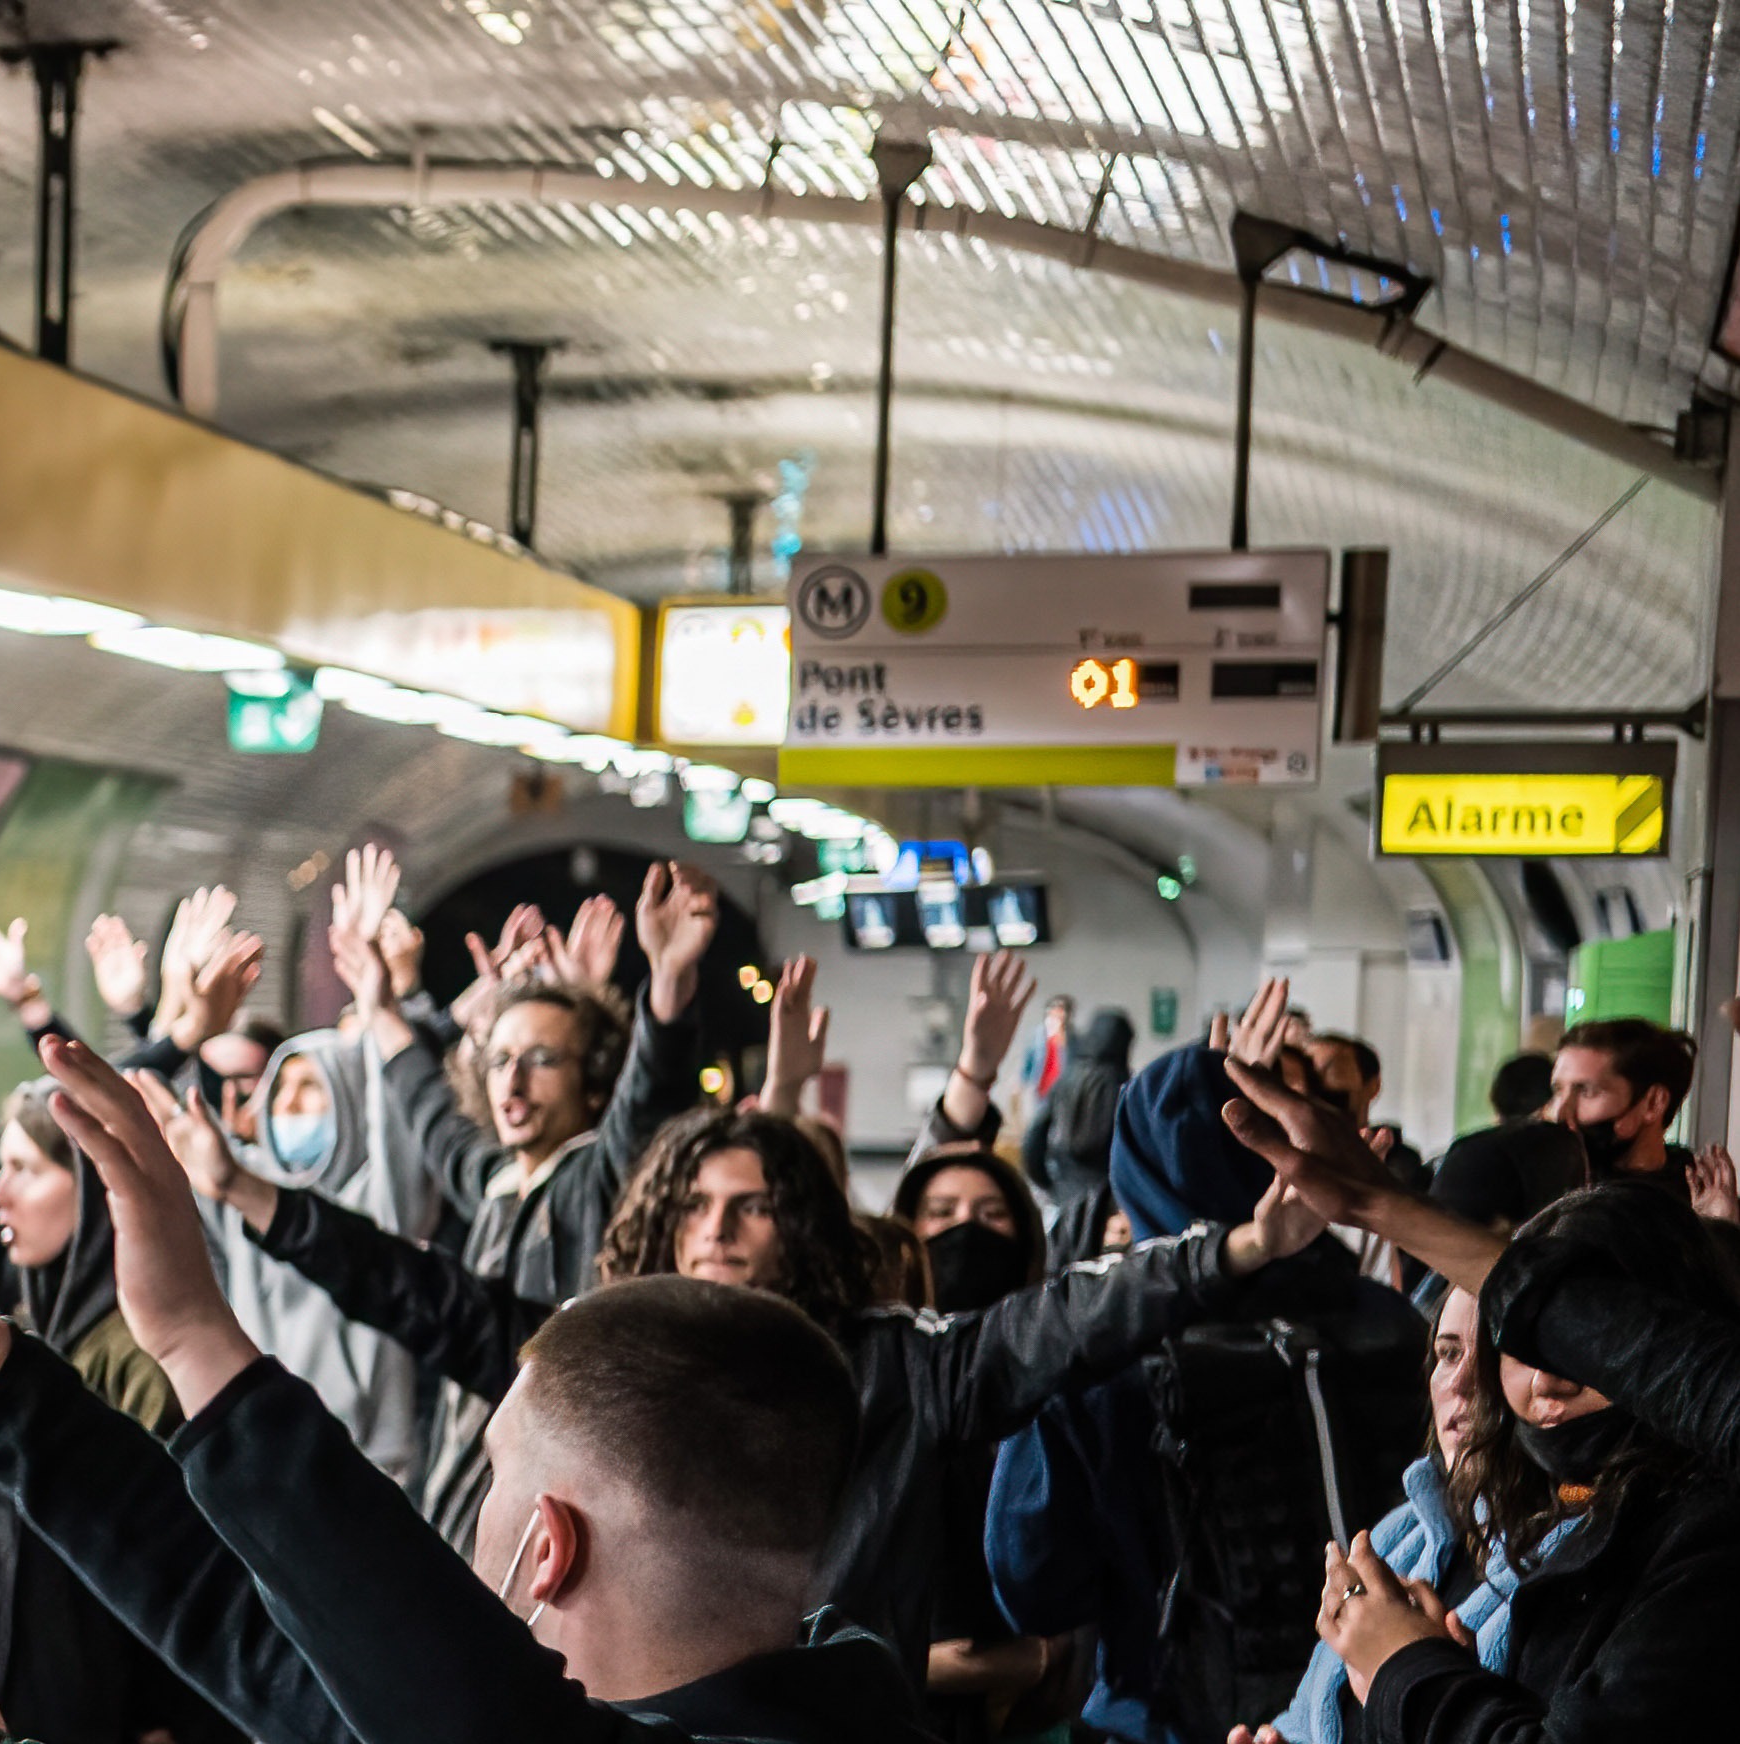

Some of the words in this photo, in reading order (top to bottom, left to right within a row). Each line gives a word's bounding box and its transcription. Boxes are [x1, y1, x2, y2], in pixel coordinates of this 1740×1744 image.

[800, 660, 888, 696] Pont
[1069, 657, 1140, 710] 01
[797, 700, 841, 738] de
[857, 697, 984, 737] Sèvres
[1406, 796, 1585, 838] Alarme
